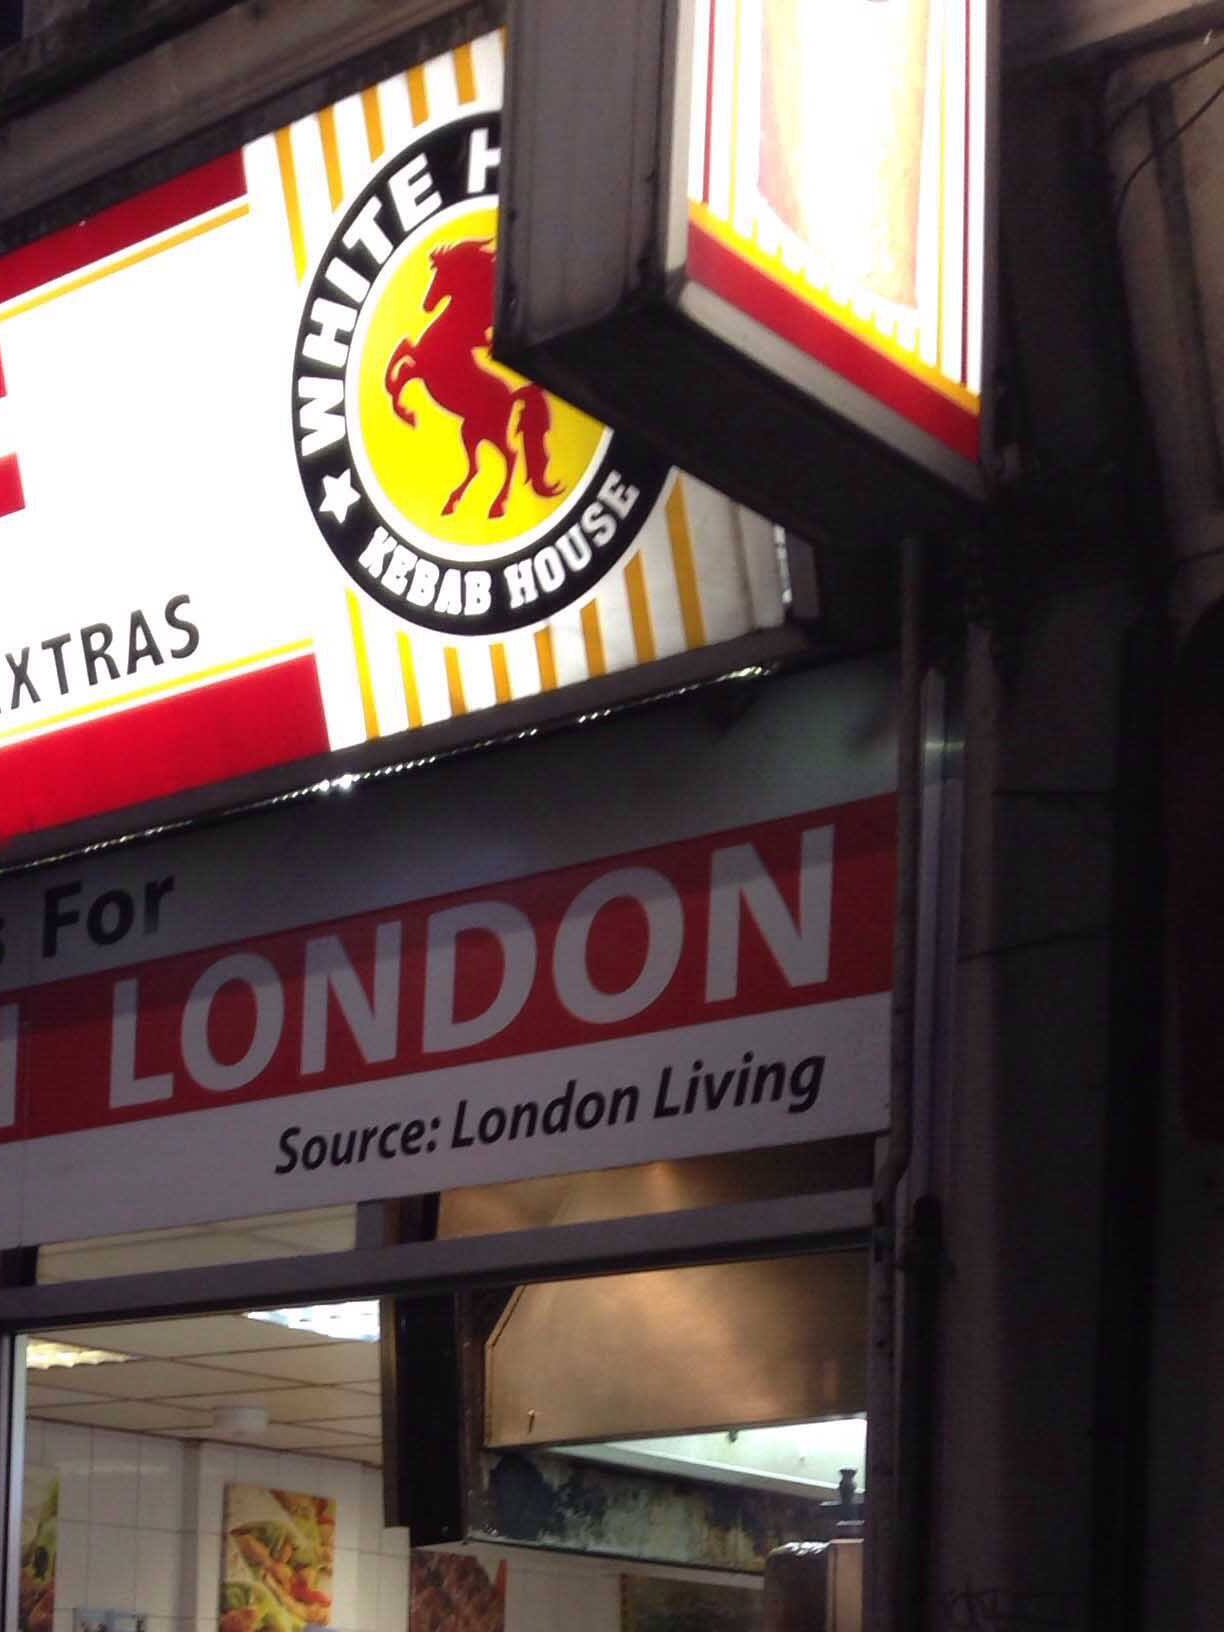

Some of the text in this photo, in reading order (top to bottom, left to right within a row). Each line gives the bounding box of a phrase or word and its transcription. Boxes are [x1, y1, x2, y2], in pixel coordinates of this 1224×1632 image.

[298, 152, 443, 457] WHITE
[358, 470, 640, 617] KEBAB HOUSE
[42, 875, 174, 958] For
[108, 823, 836, 1110] LONDON
[274, 1049, 827, 1176] Source: London Living
